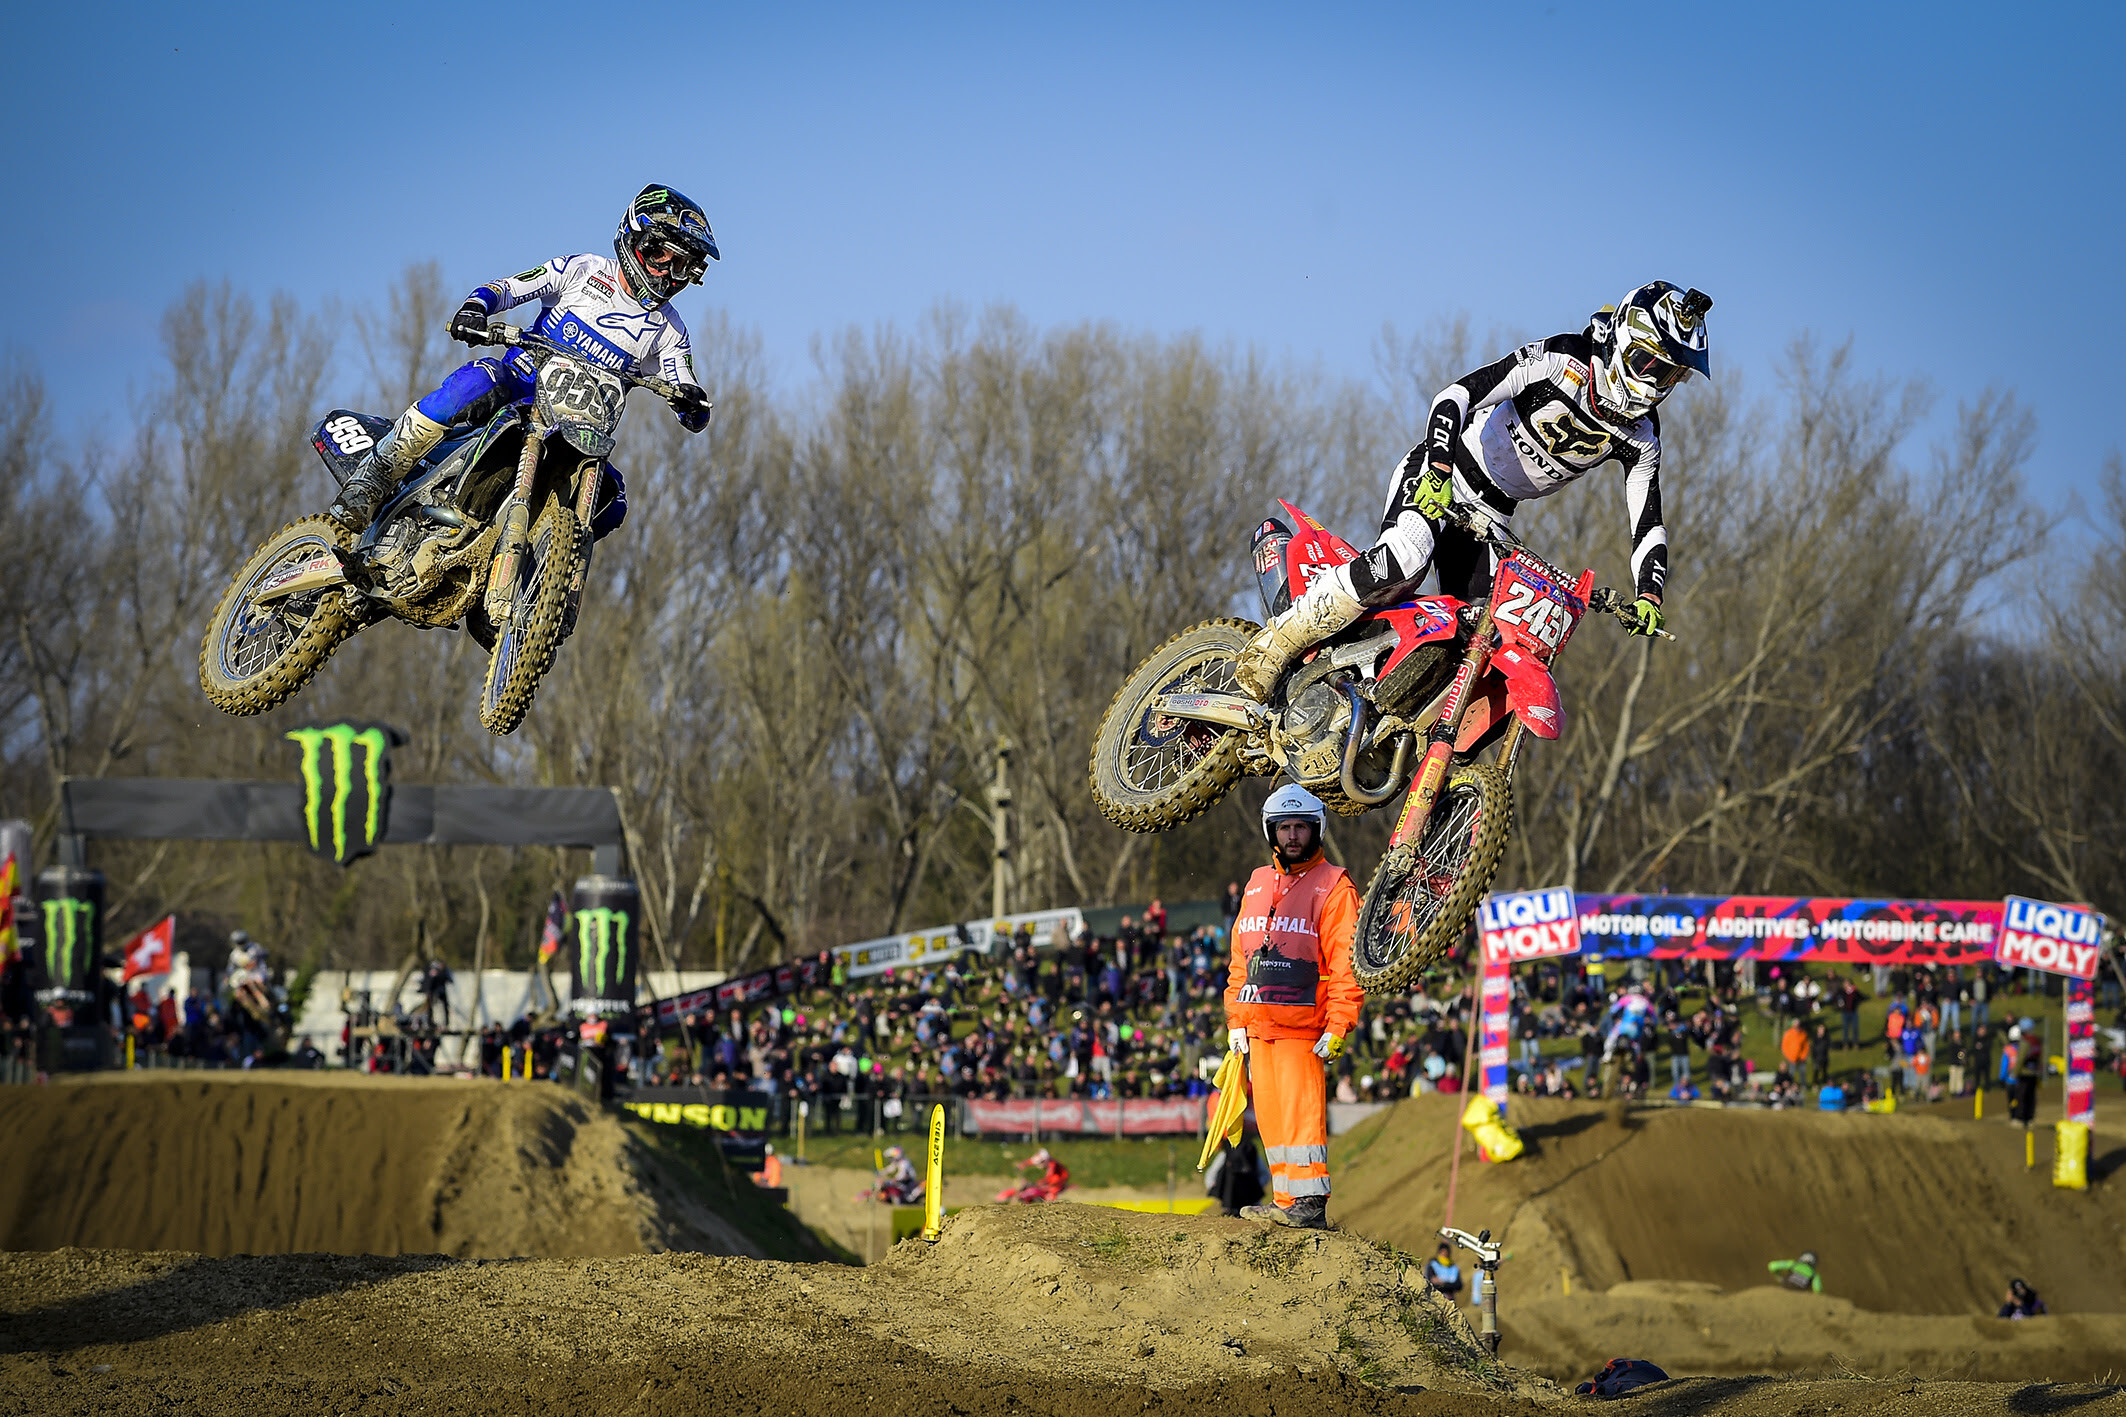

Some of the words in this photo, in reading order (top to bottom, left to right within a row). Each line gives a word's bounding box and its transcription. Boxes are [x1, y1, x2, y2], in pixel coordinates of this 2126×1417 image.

[512, 282, 553, 306] YAMAHA
[588, 278, 614, 298] WILVO
[575, 330, 625, 370] YAMAHA
[545, 368, 621, 421] 959
[325, 415, 374, 455] 959
[1435, 413, 1454, 453] FOX
[1505, 420, 1565, 482] HOND
[309, 559, 331, 570] RK
[1335, 547, 1356, 562] HON
[1515, 553, 1577, 593] RENTHAL
[1652, 560, 1667, 588] OX
[1494, 581, 1573, 648] 243
[1441, 666, 1468, 721] SHOWA
[1396, 793, 1413, 831] ACERBIS
[1484, 892, 1570, 932] LIQUI
[1581, 914, 1647, 935] MOTOR
[1648, 914, 1696, 936] OILS
[1707, 916, 1809, 939] ADDITIVES
[1820, 917, 1936, 942] MOTORBIKE
[1937, 919, 1993, 943] CARE
[2008, 901, 2098, 943] LIQUI
[1483, 921, 1574, 961] MOLY
[2002, 930, 2096, 973] MOLY
[1260, 960, 1292, 968] MONSTER
[623, 1102, 768, 1132] NSON
[933, 1120, 941, 1166] ACERBIS
